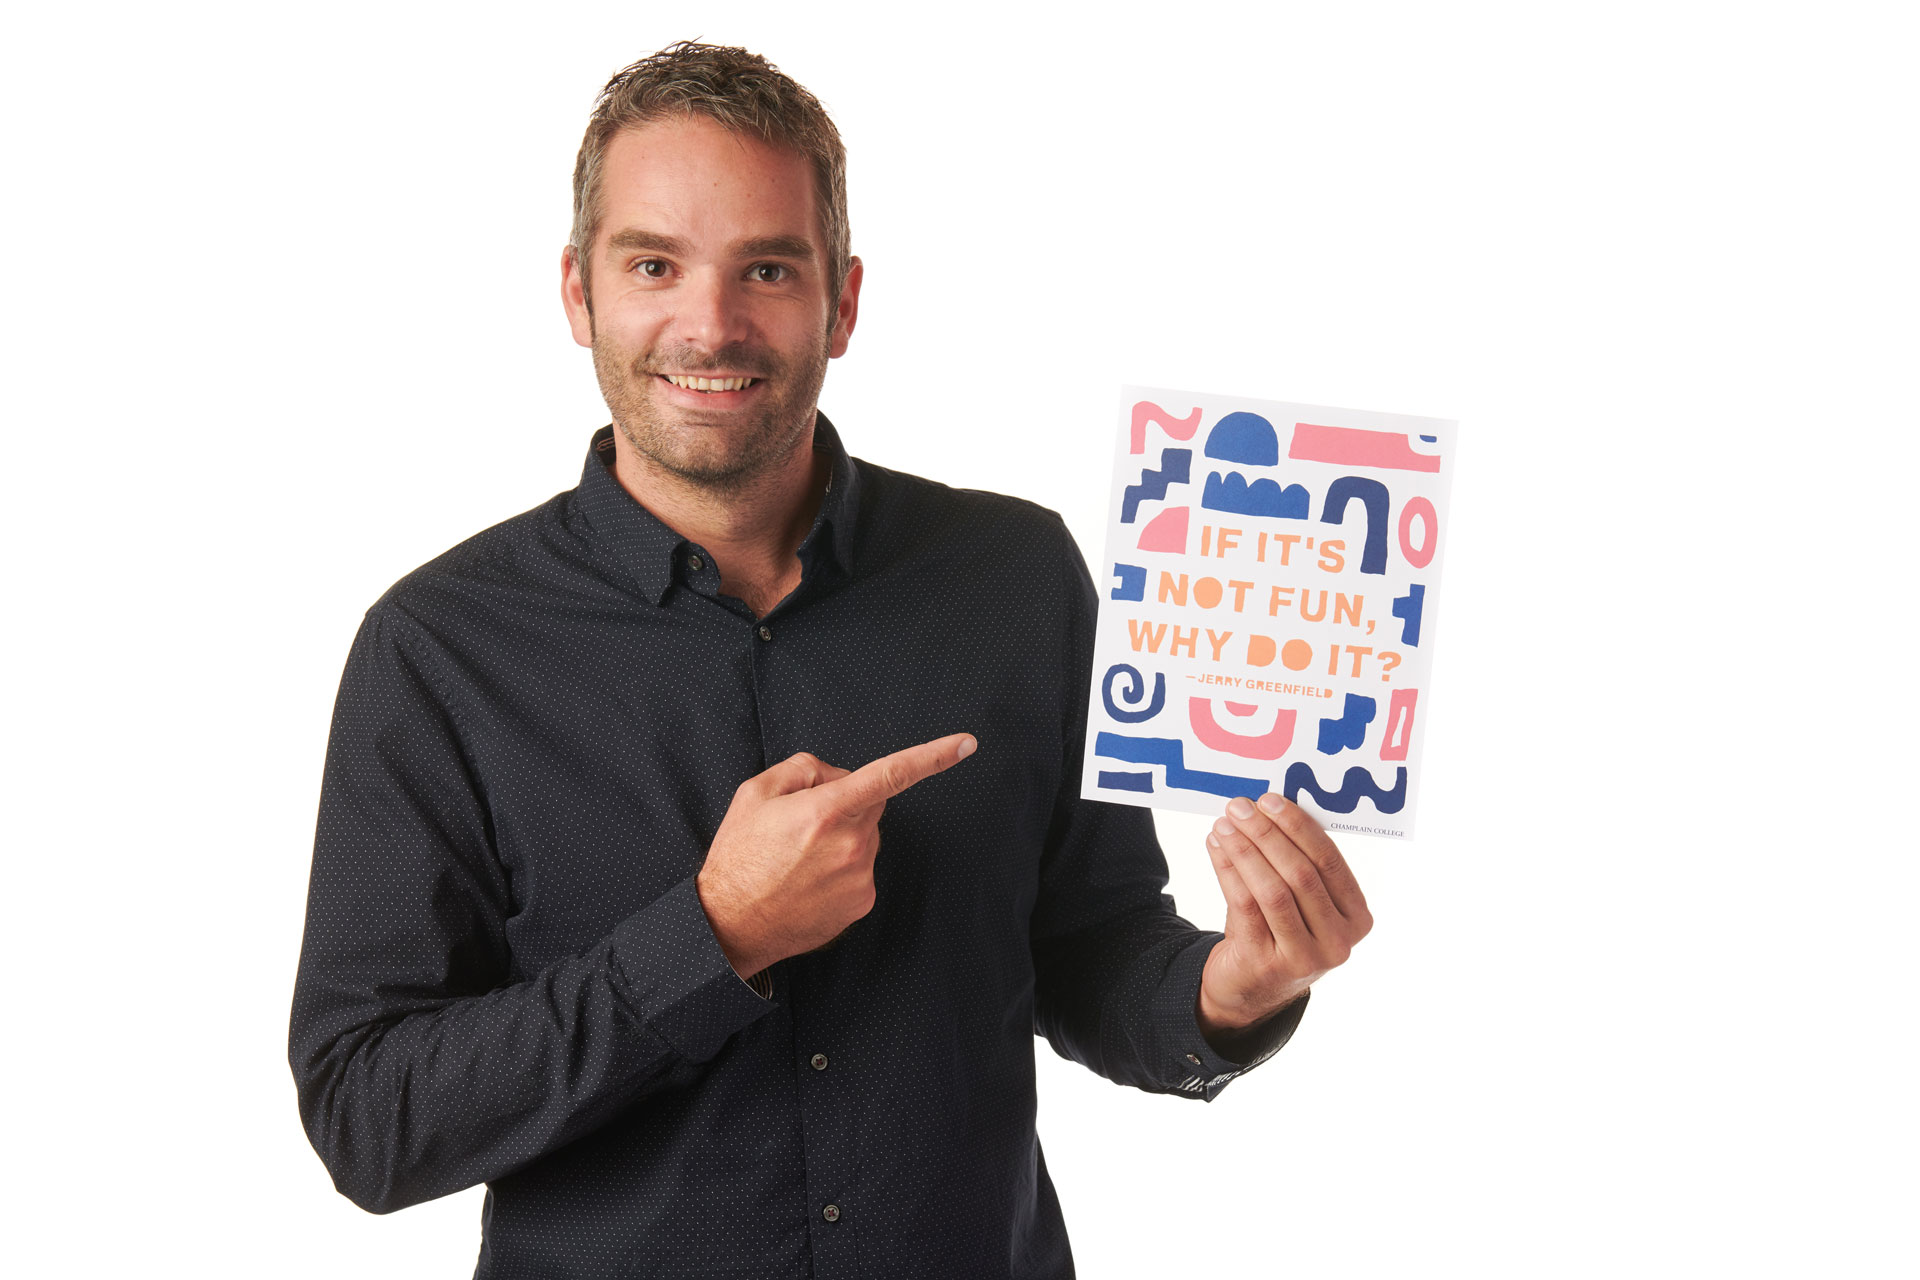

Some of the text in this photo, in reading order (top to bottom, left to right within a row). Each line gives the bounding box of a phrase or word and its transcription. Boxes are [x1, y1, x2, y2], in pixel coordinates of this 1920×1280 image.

[1200, 525, 1346, 574] IF IT'S
[1157, 570, 1377, 636] NOT FUN,
[1127, 619, 1402, 683] WHY DO IT?
[1245, 679, 1333, 699] GREENFIELD
[1330, 822, 1405, 837] CHAMPLAIN COLLEGE
